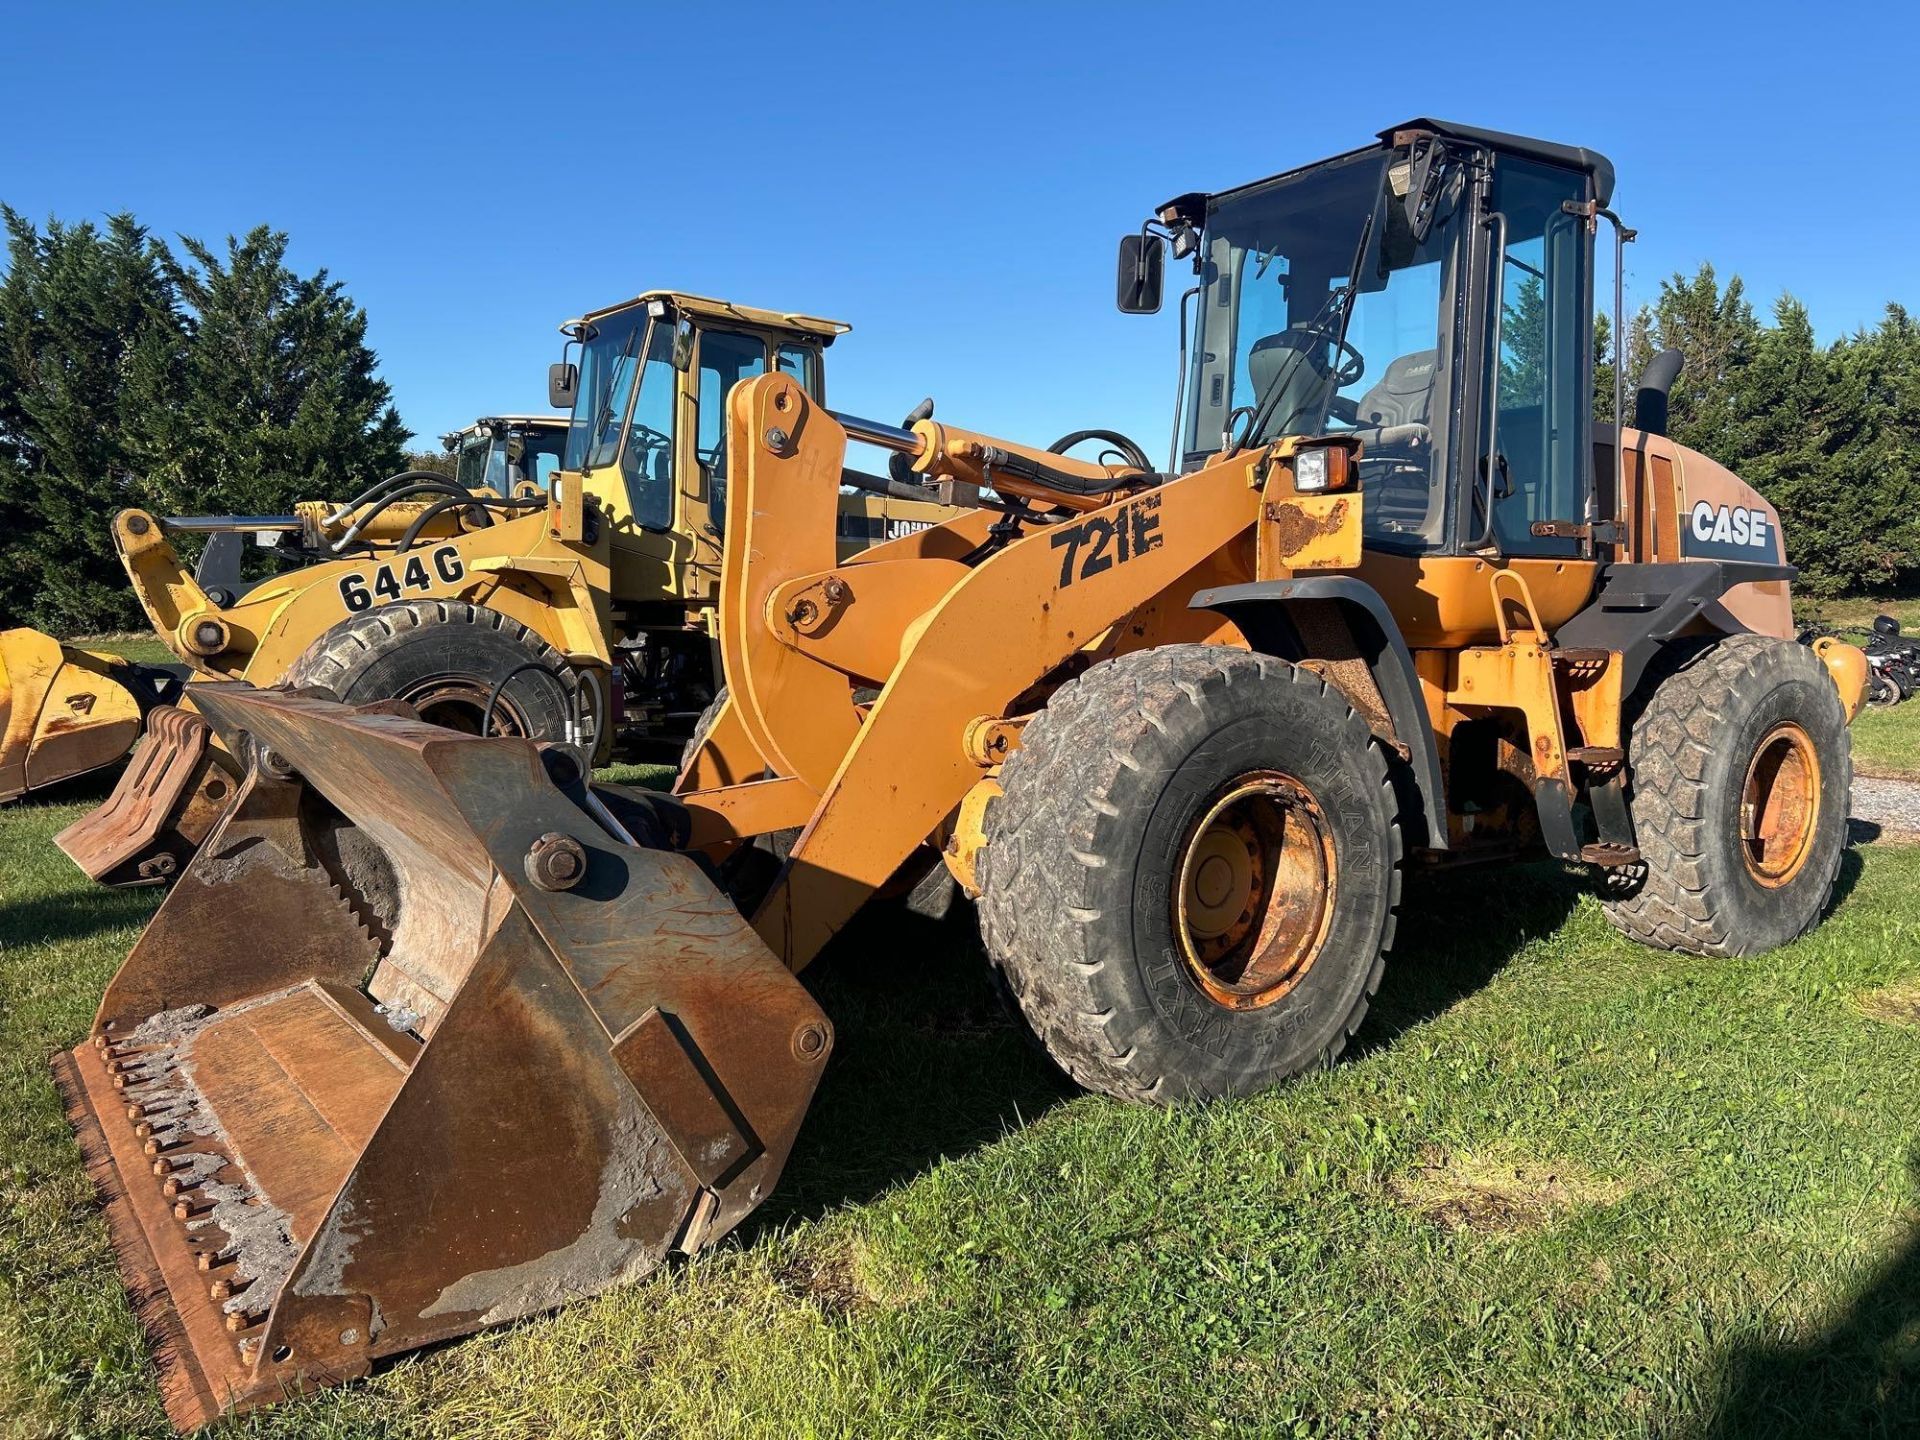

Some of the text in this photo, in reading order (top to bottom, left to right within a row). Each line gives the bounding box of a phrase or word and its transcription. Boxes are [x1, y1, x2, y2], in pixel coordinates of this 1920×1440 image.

[1050, 492, 1164, 589] 721E
[1691, 499, 1767, 547] CASE
[338, 545, 465, 614] 644G
[1303, 737, 1374, 877] TITAN
